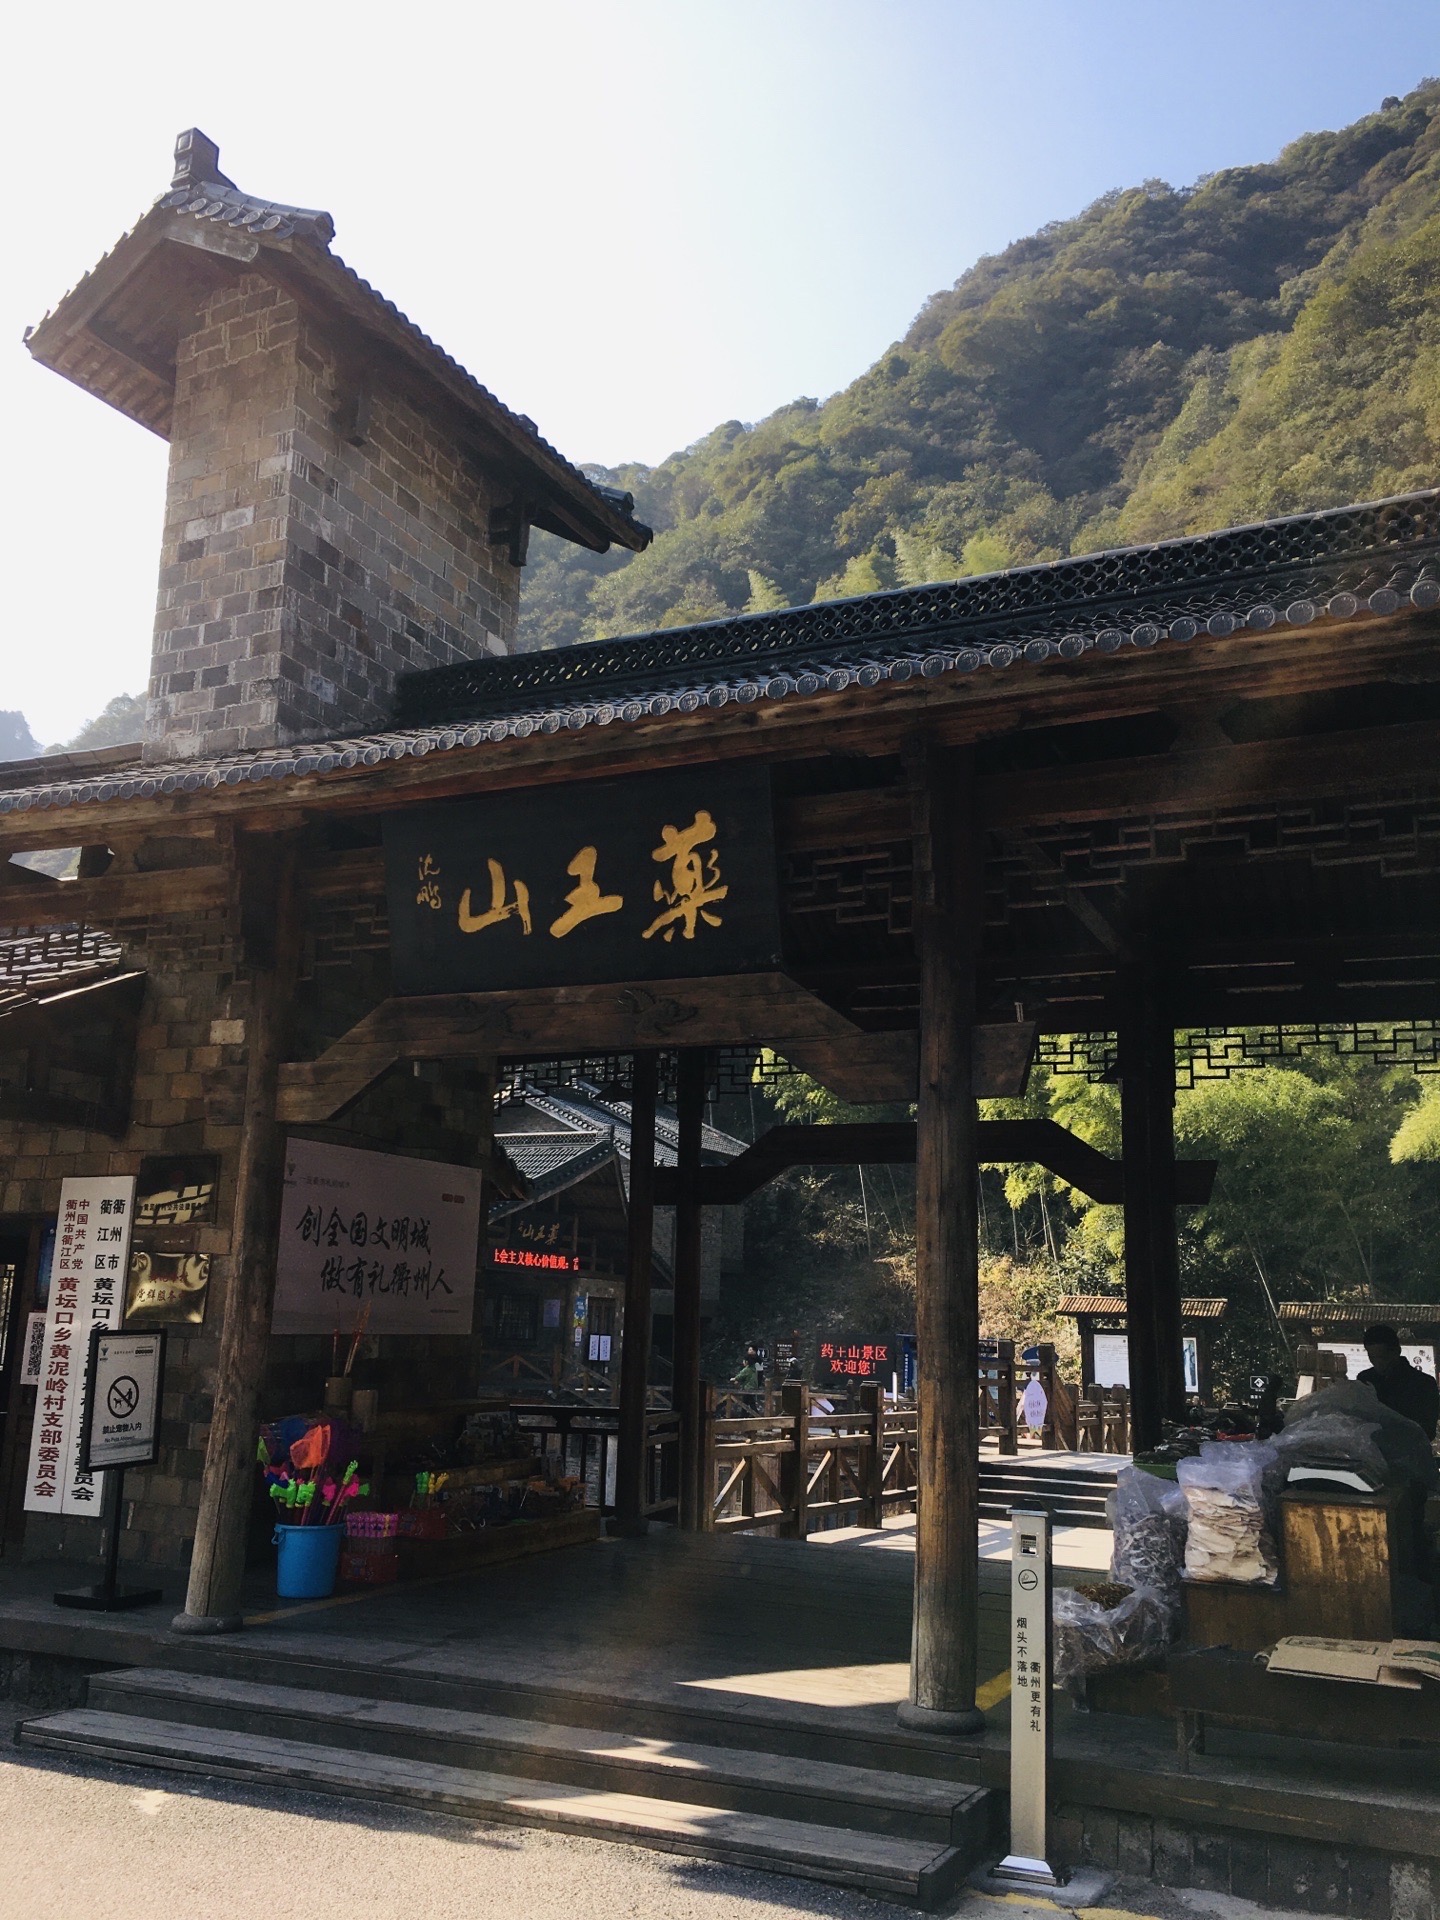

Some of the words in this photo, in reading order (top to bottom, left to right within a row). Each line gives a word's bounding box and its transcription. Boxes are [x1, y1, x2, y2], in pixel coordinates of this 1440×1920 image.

[60, 1199, 78, 1270] 衢州市衢江区
[72, 1199, 90, 1270] 中国共产党
[295, 1204, 432, 1256] 创全国文明城
[320, 1255, 454, 1301] 做有礼衢州人
[33, 1276, 81, 1499] 黄坛口乡黄泥岭村支部委员会
[102, 1422, 142, 1435] 禁止宠物入内
[1016, 1617, 1028, 1688] 烟头不落地
[1030, 1661, 1041, 1732] 衢州更有礼
